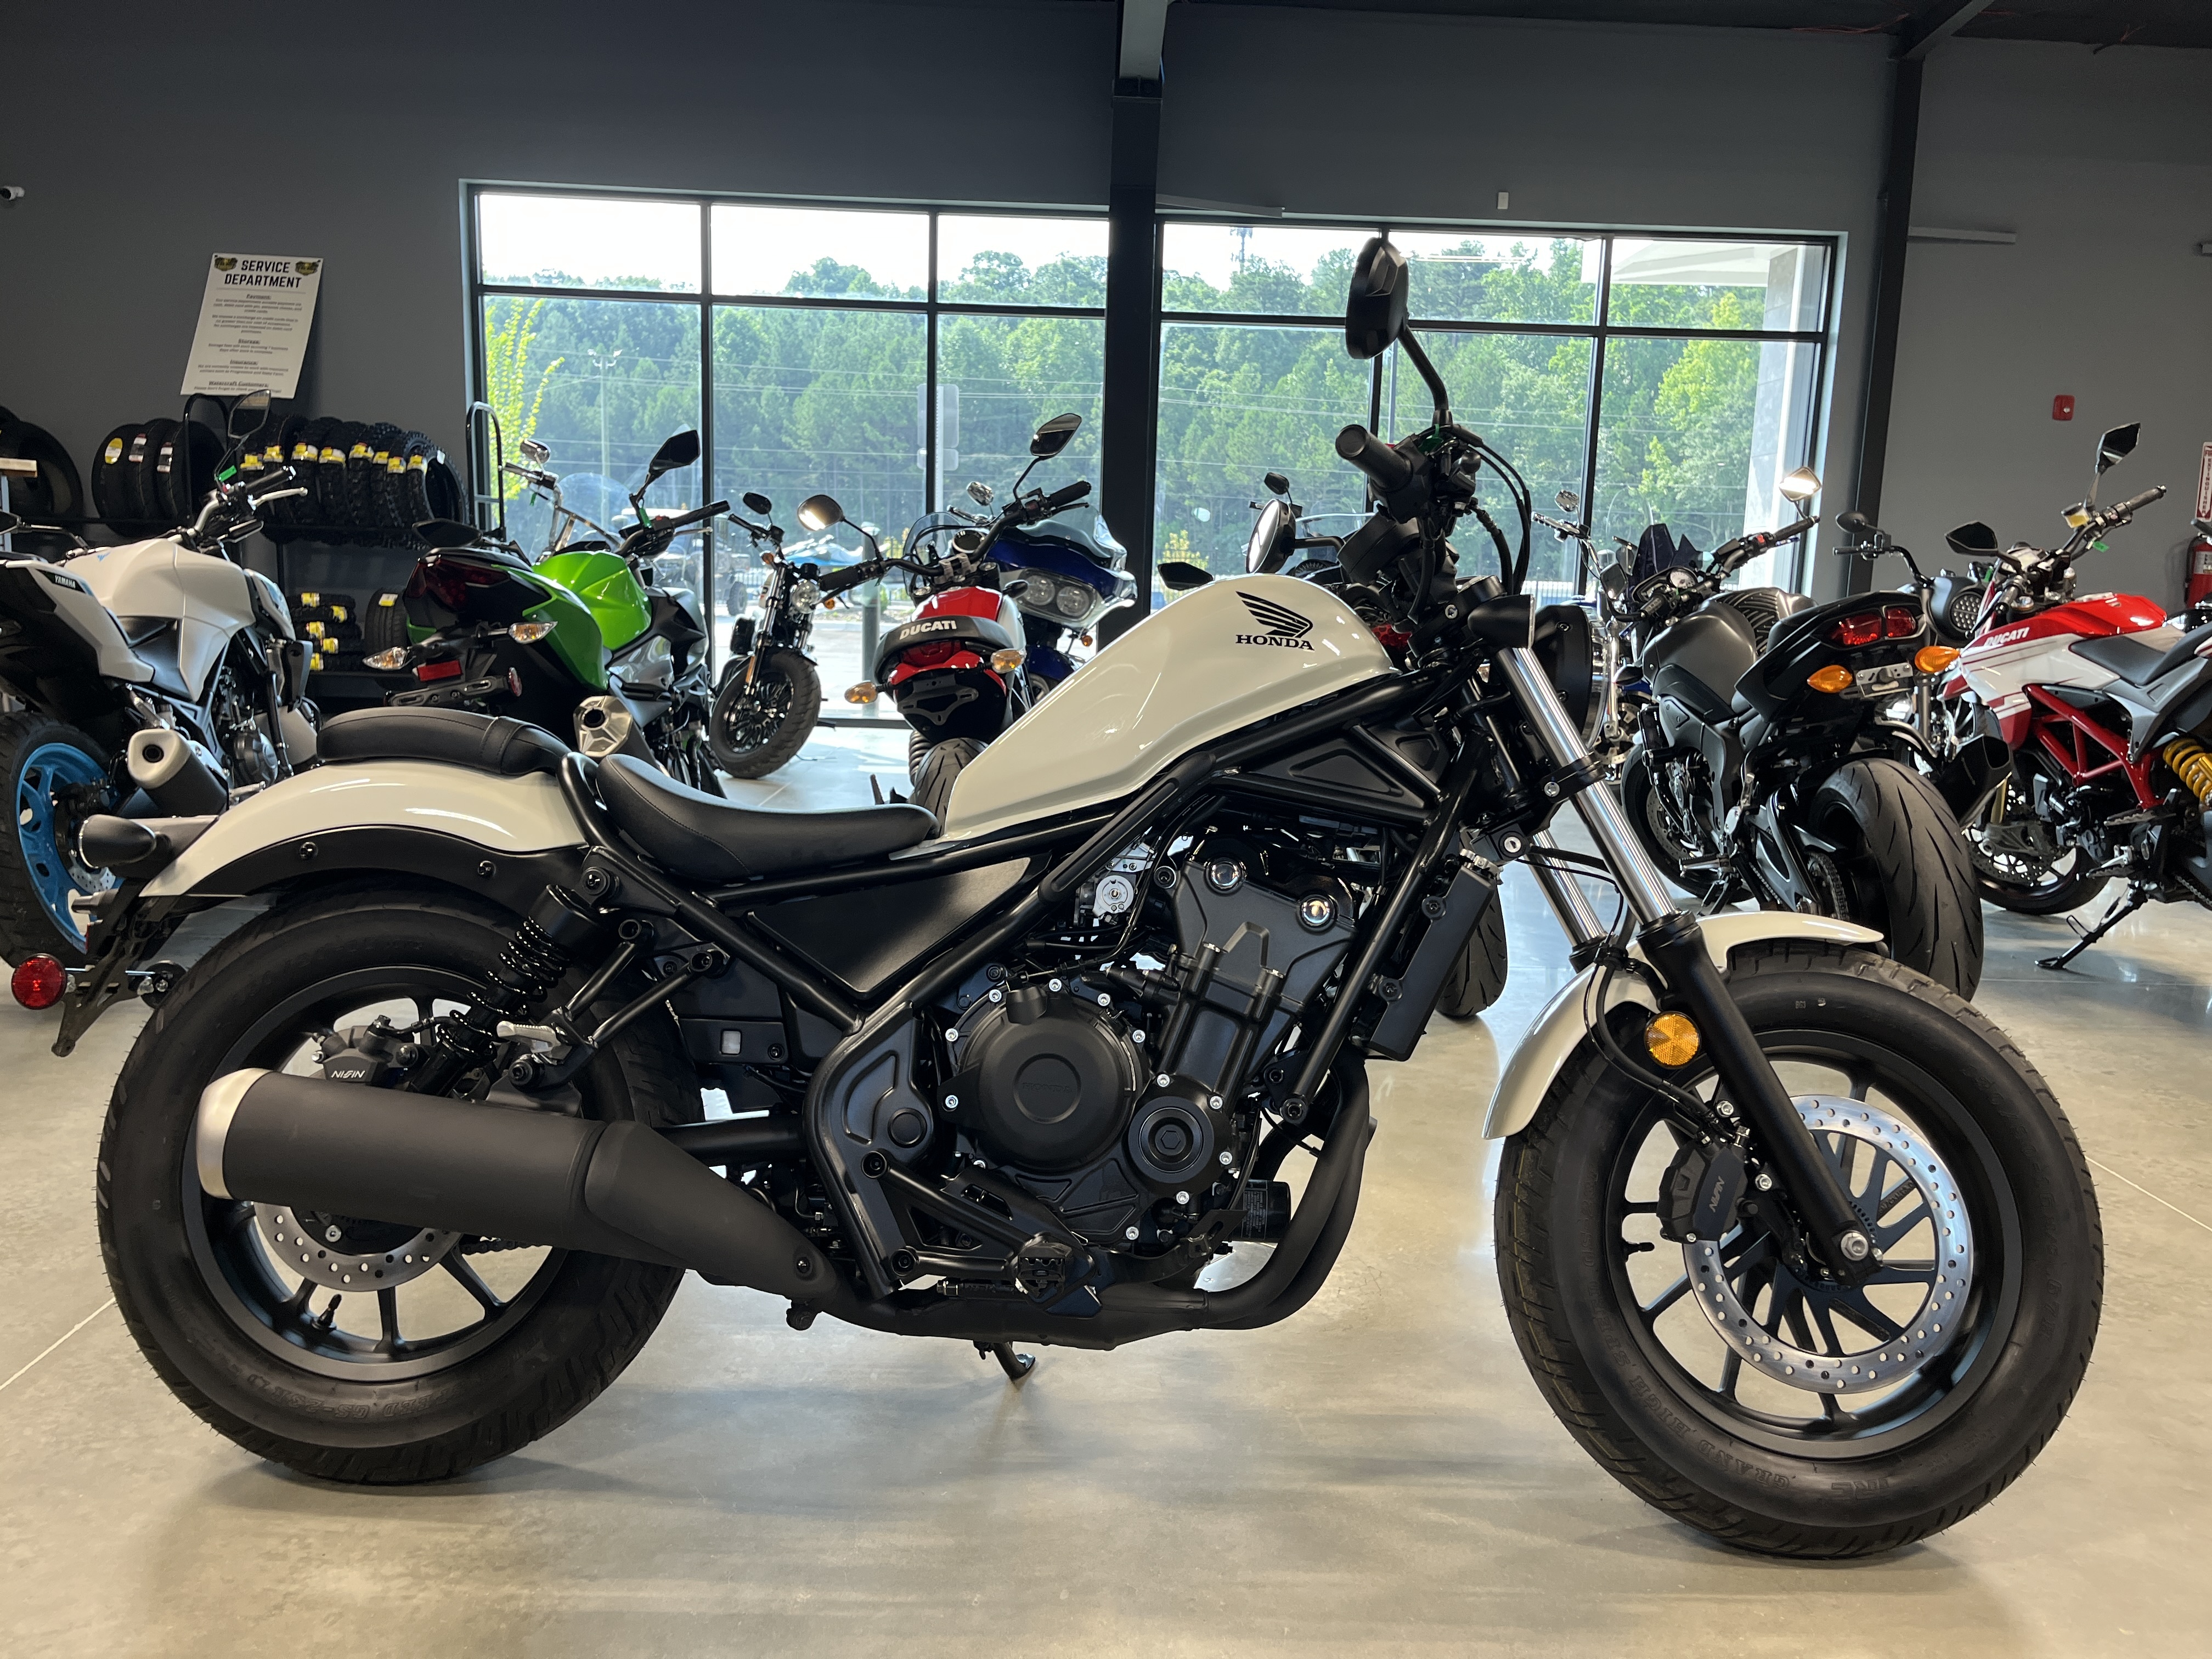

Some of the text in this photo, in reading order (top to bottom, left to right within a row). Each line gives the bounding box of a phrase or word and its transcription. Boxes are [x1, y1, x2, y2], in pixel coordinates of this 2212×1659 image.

[241, 259, 291, 273] SERVICE
[224, 273, 302, 288] DEPARTMENT
[55, 574, 76, 589] YAMAHA
[899, 620, 957, 640] DUCATI
[1984, 627, 2030, 646] DUCATI
[1235, 634, 1315, 651] HONDA
[1585, 1280, 1631, 1367] SPEED
[1628, 1374, 1692, 1438] HIGH
[1697, 1438, 1790, 1491] GRAND
